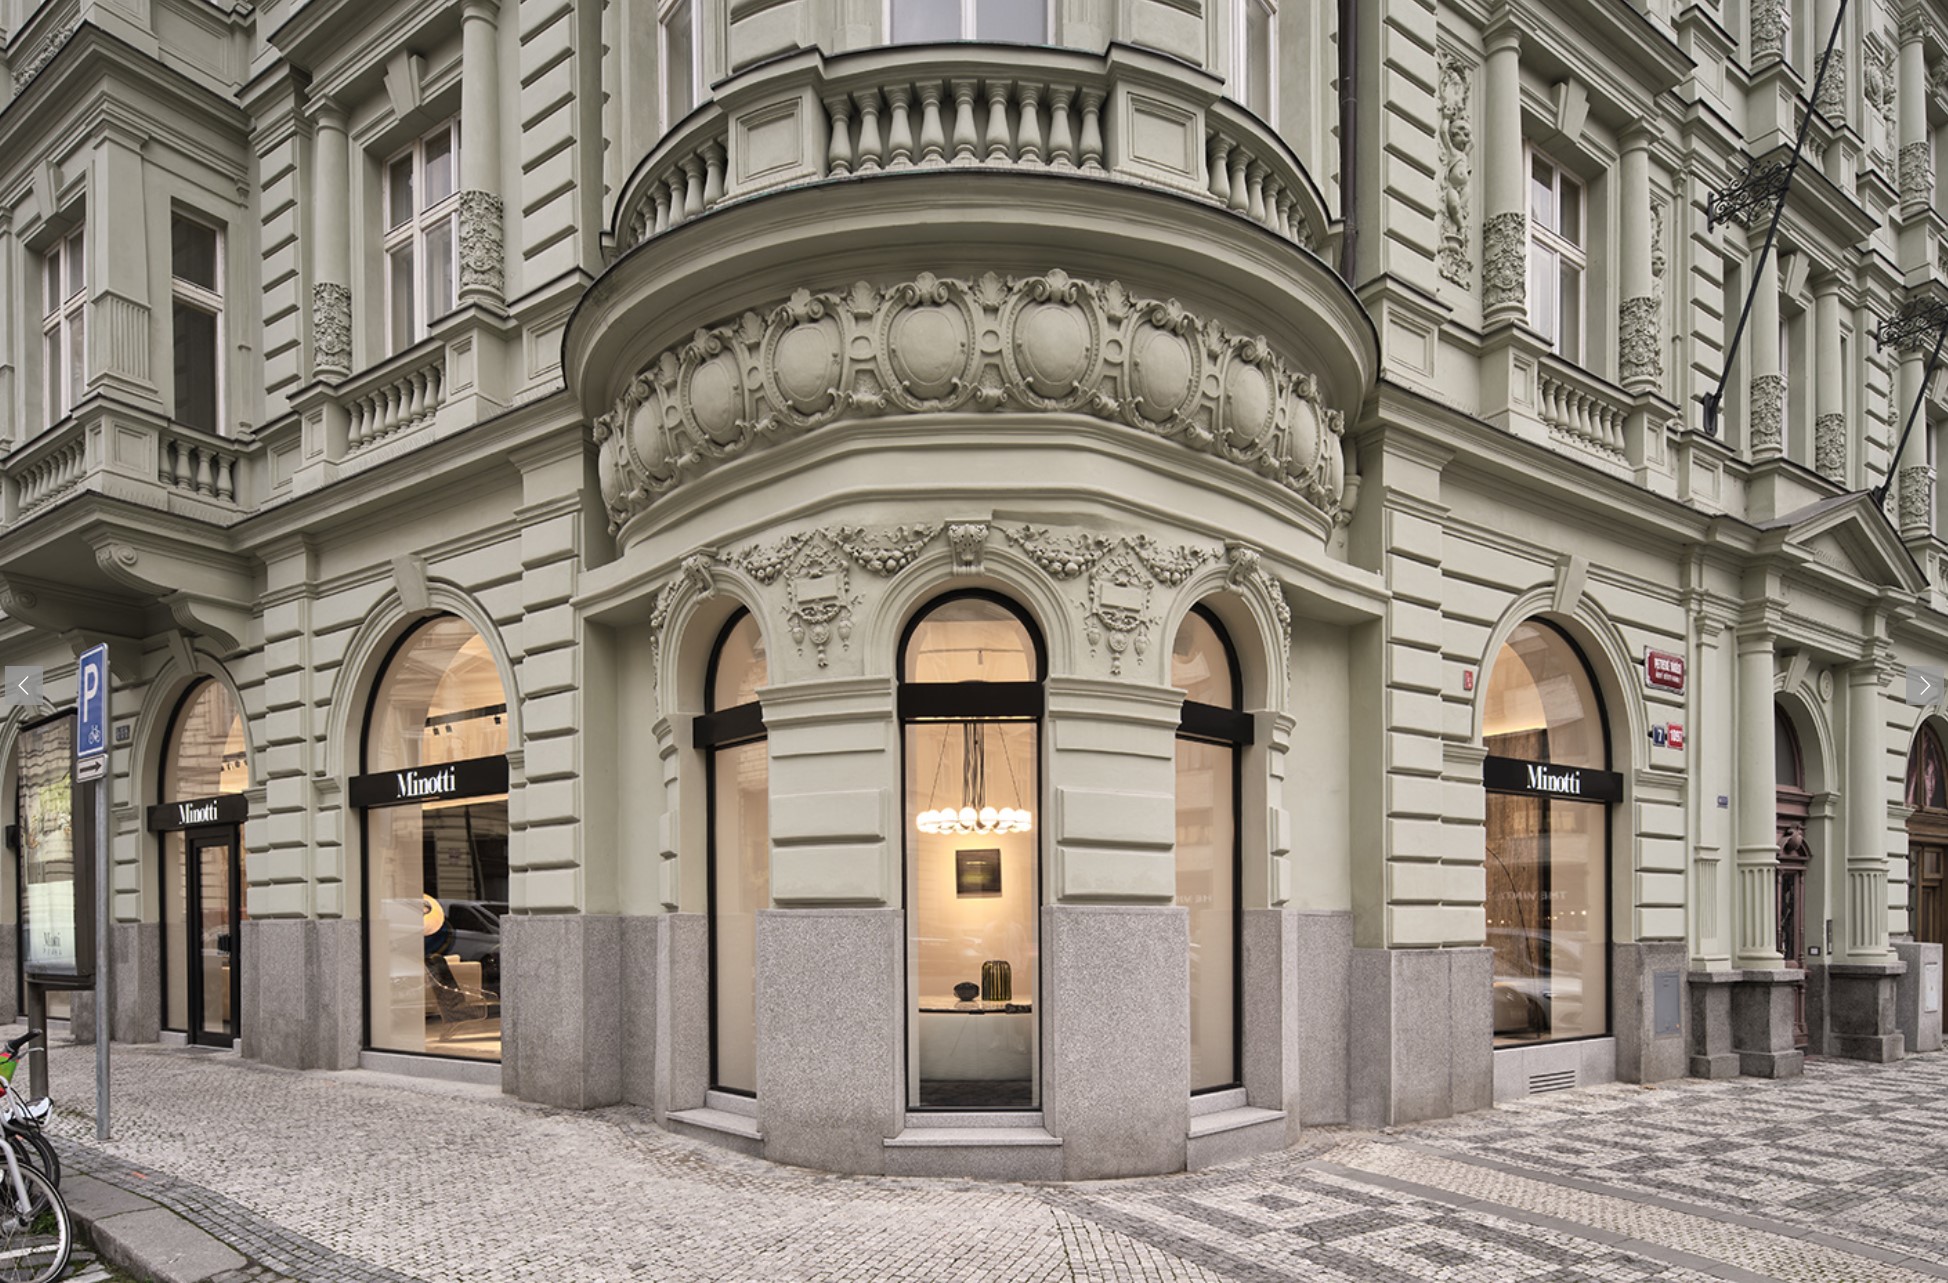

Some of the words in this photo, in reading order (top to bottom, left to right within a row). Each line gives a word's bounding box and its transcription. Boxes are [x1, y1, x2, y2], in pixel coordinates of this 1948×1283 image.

[84, 663, 98, 722] P
[1657, 729, 1663, 742] 7
[397, 766, 456, 798] Minotti
[1527, 764, 1581, 794] Minotti
[179, 799, 218, 825] Minotti
